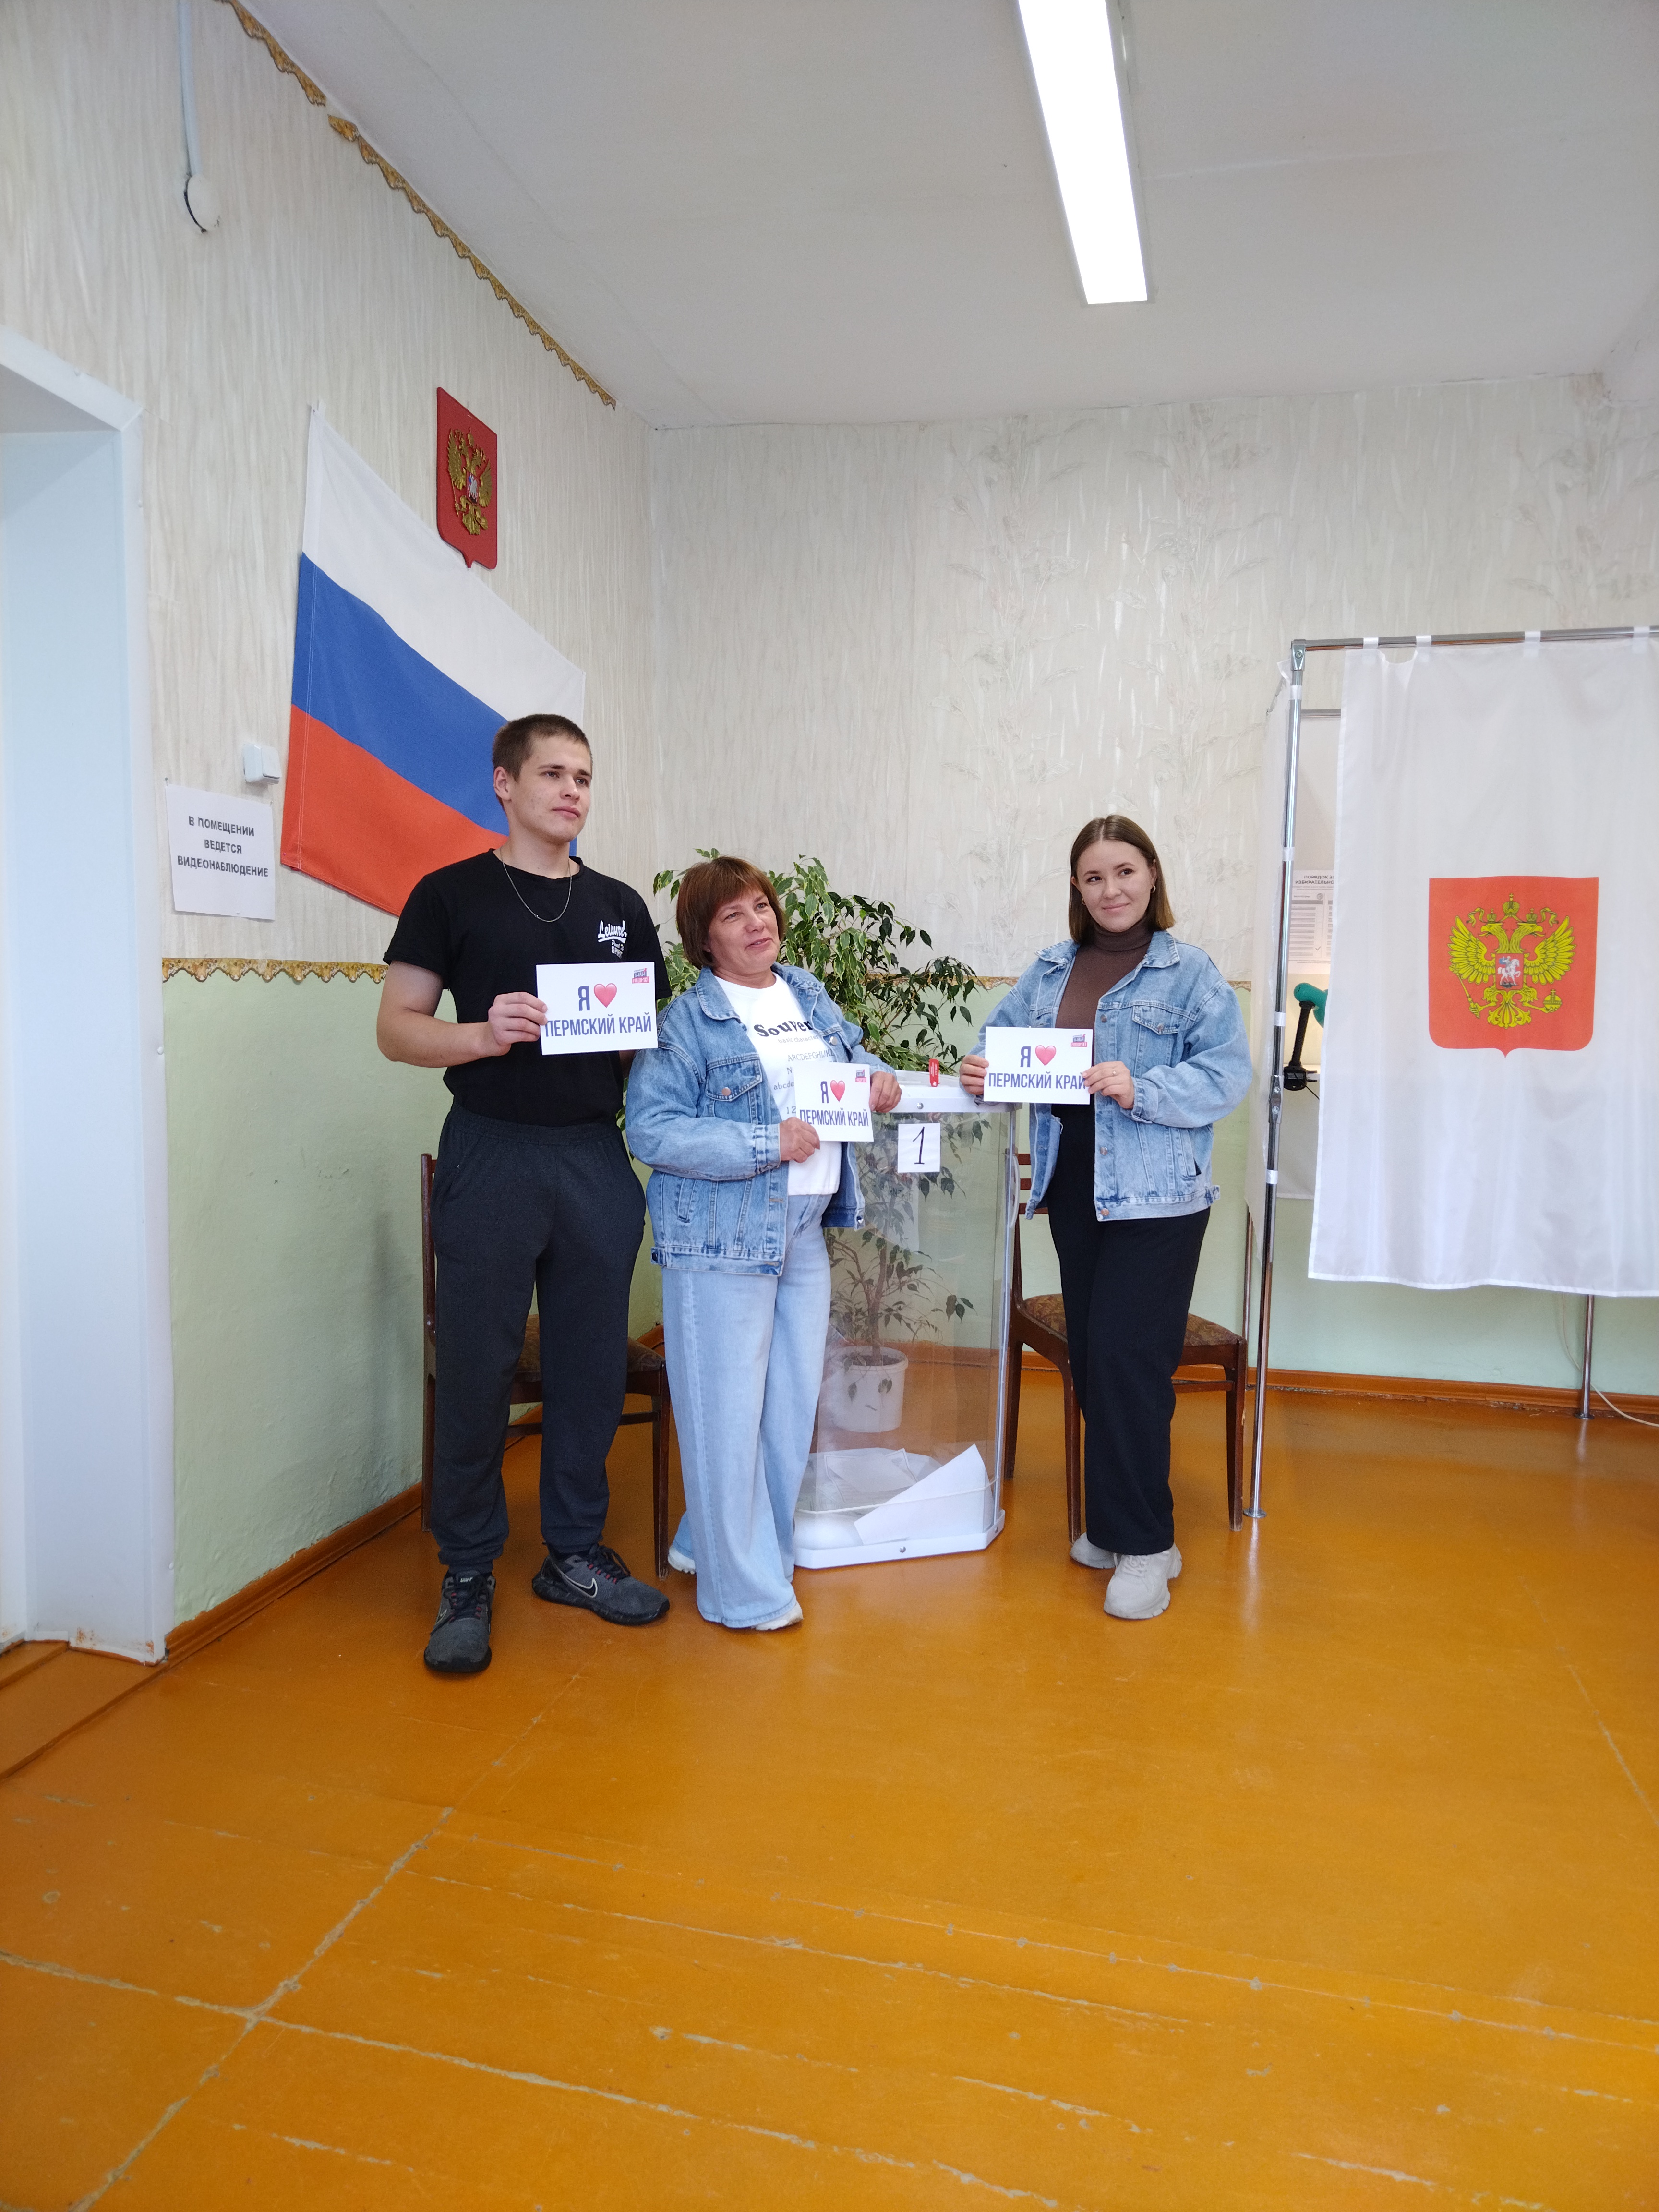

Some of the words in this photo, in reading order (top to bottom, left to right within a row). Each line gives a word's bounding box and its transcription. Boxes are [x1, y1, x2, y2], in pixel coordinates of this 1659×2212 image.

[189, 816, 194, 826] В
[198, 817, 254, 837] ПОМЕЩЕНИИ
[204, 839, 242, 854] ВЕДЕТСЯ
[177, 855, 268, 877] ВИДЕОНАБЛЮДЕНИЕ
[577, 986, 590, 1011] Я
[545, 1013, 615, 1037] ПЕРМСКИЙ
[619, 1012, 651, 1033] КРАЙ
[1020, 1046, 1031, 1068] Я
[988, 1071, 1052, 1089] ПЕРМСКИЙ
[820, 1081, 829, 1104] Я
[800, 1107, 846, 1125] ПЕРМСКИЙ
[847, 1108, 869, 1126] КРАЙ
[912, 1126, 925, 1165] 1
